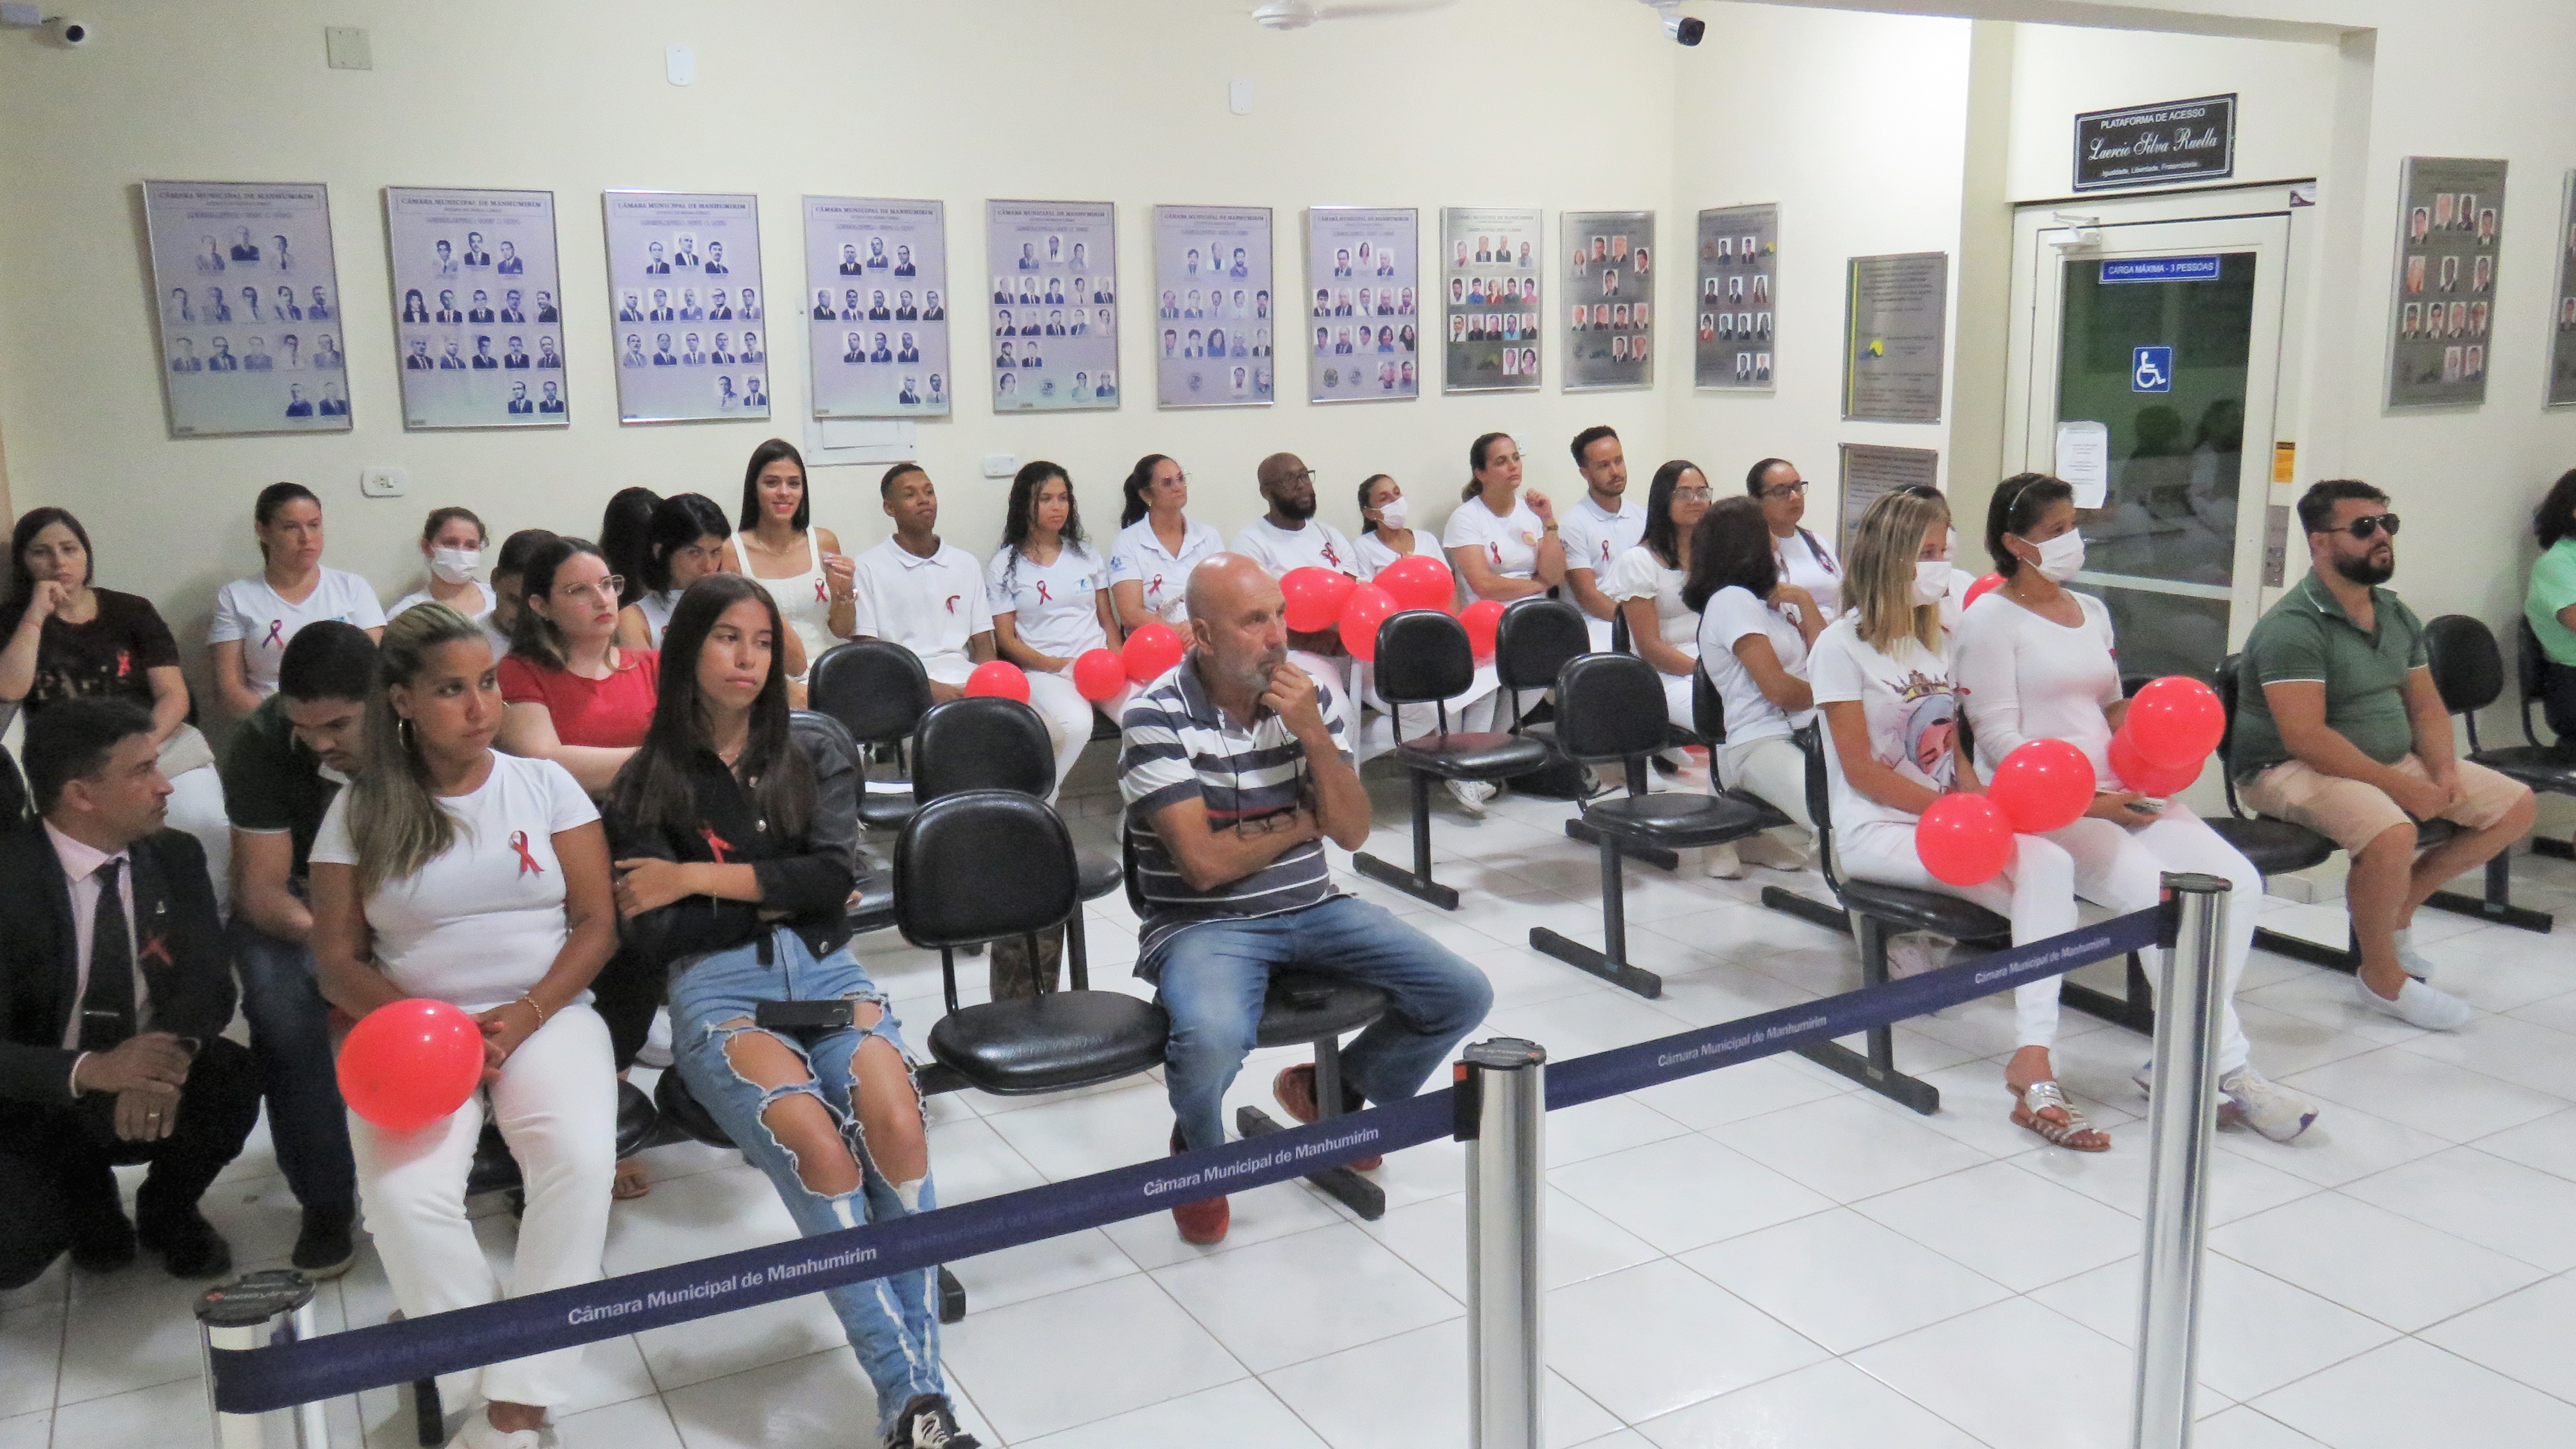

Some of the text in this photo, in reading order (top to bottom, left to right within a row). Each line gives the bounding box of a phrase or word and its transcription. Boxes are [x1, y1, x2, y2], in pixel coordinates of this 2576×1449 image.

[2101, 107, 2205, 129] PLATAFORMA DE ACESSO
[2088, 127, 2218, 160] Laercio Silva Ruella
[2108, 265, 2134, 274] CARGA
[2135, 263, 2165, 273] MÁXIMA
[2170, 264, 2175, 273] 3
[2177, 262, 2214, 272] PESSOAS
[1658, 1016, 1827, 1067] Câmara Municipal de Manhumirim
[1143, 1128, 1379, 1196] Câmara Municipal de Manhumirim
[568, 1246, 878, 1325] Câmara Municipal de Manhumirim
